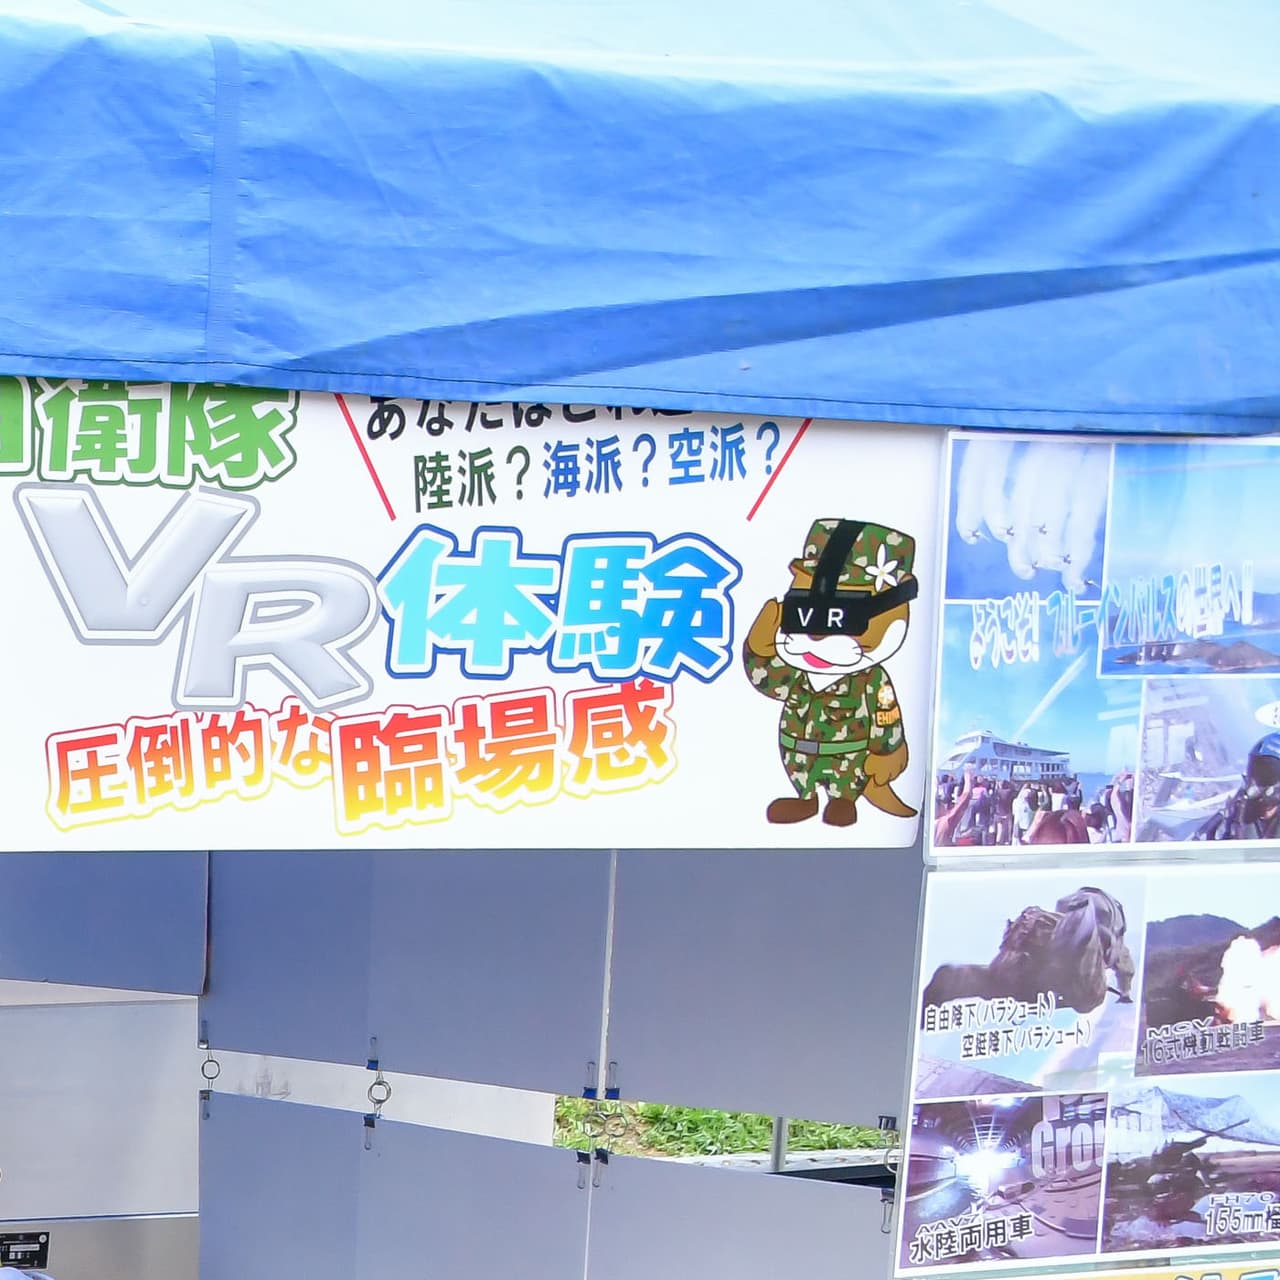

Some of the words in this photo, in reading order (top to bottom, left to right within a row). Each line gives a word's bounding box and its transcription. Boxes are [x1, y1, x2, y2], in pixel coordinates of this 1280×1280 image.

[15, 484, 742, 711] VR体験
[798, 608, 843, 627] VR
[47, 682, 675, 834] 圧倒的な臨場感
[910, 1214, 1033, 1263] 水陸両用車
